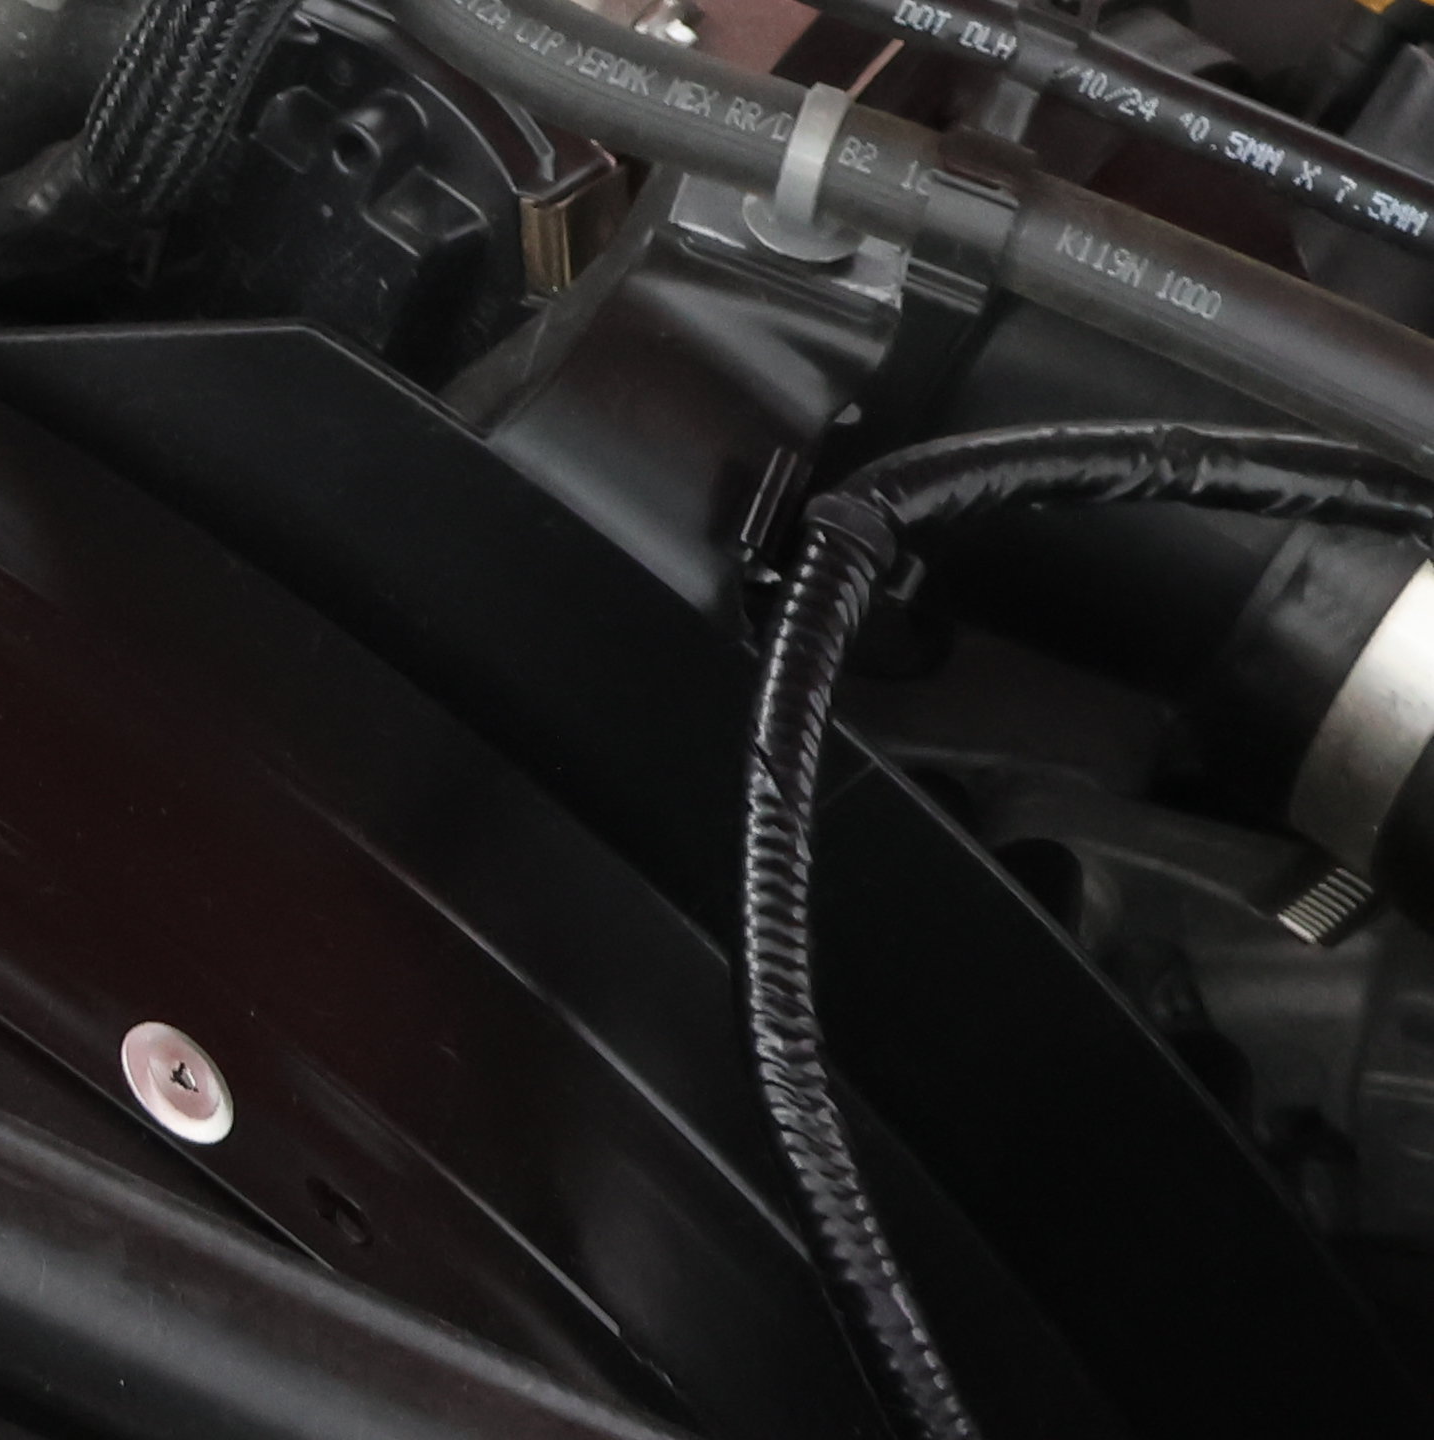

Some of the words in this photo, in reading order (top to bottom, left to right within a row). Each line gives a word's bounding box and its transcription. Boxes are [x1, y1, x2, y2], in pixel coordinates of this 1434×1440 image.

[663, 76, 721, 119] MEX
[1153, 267, 1223, 320] 1000
[1291, 159, 1322, 192] X
